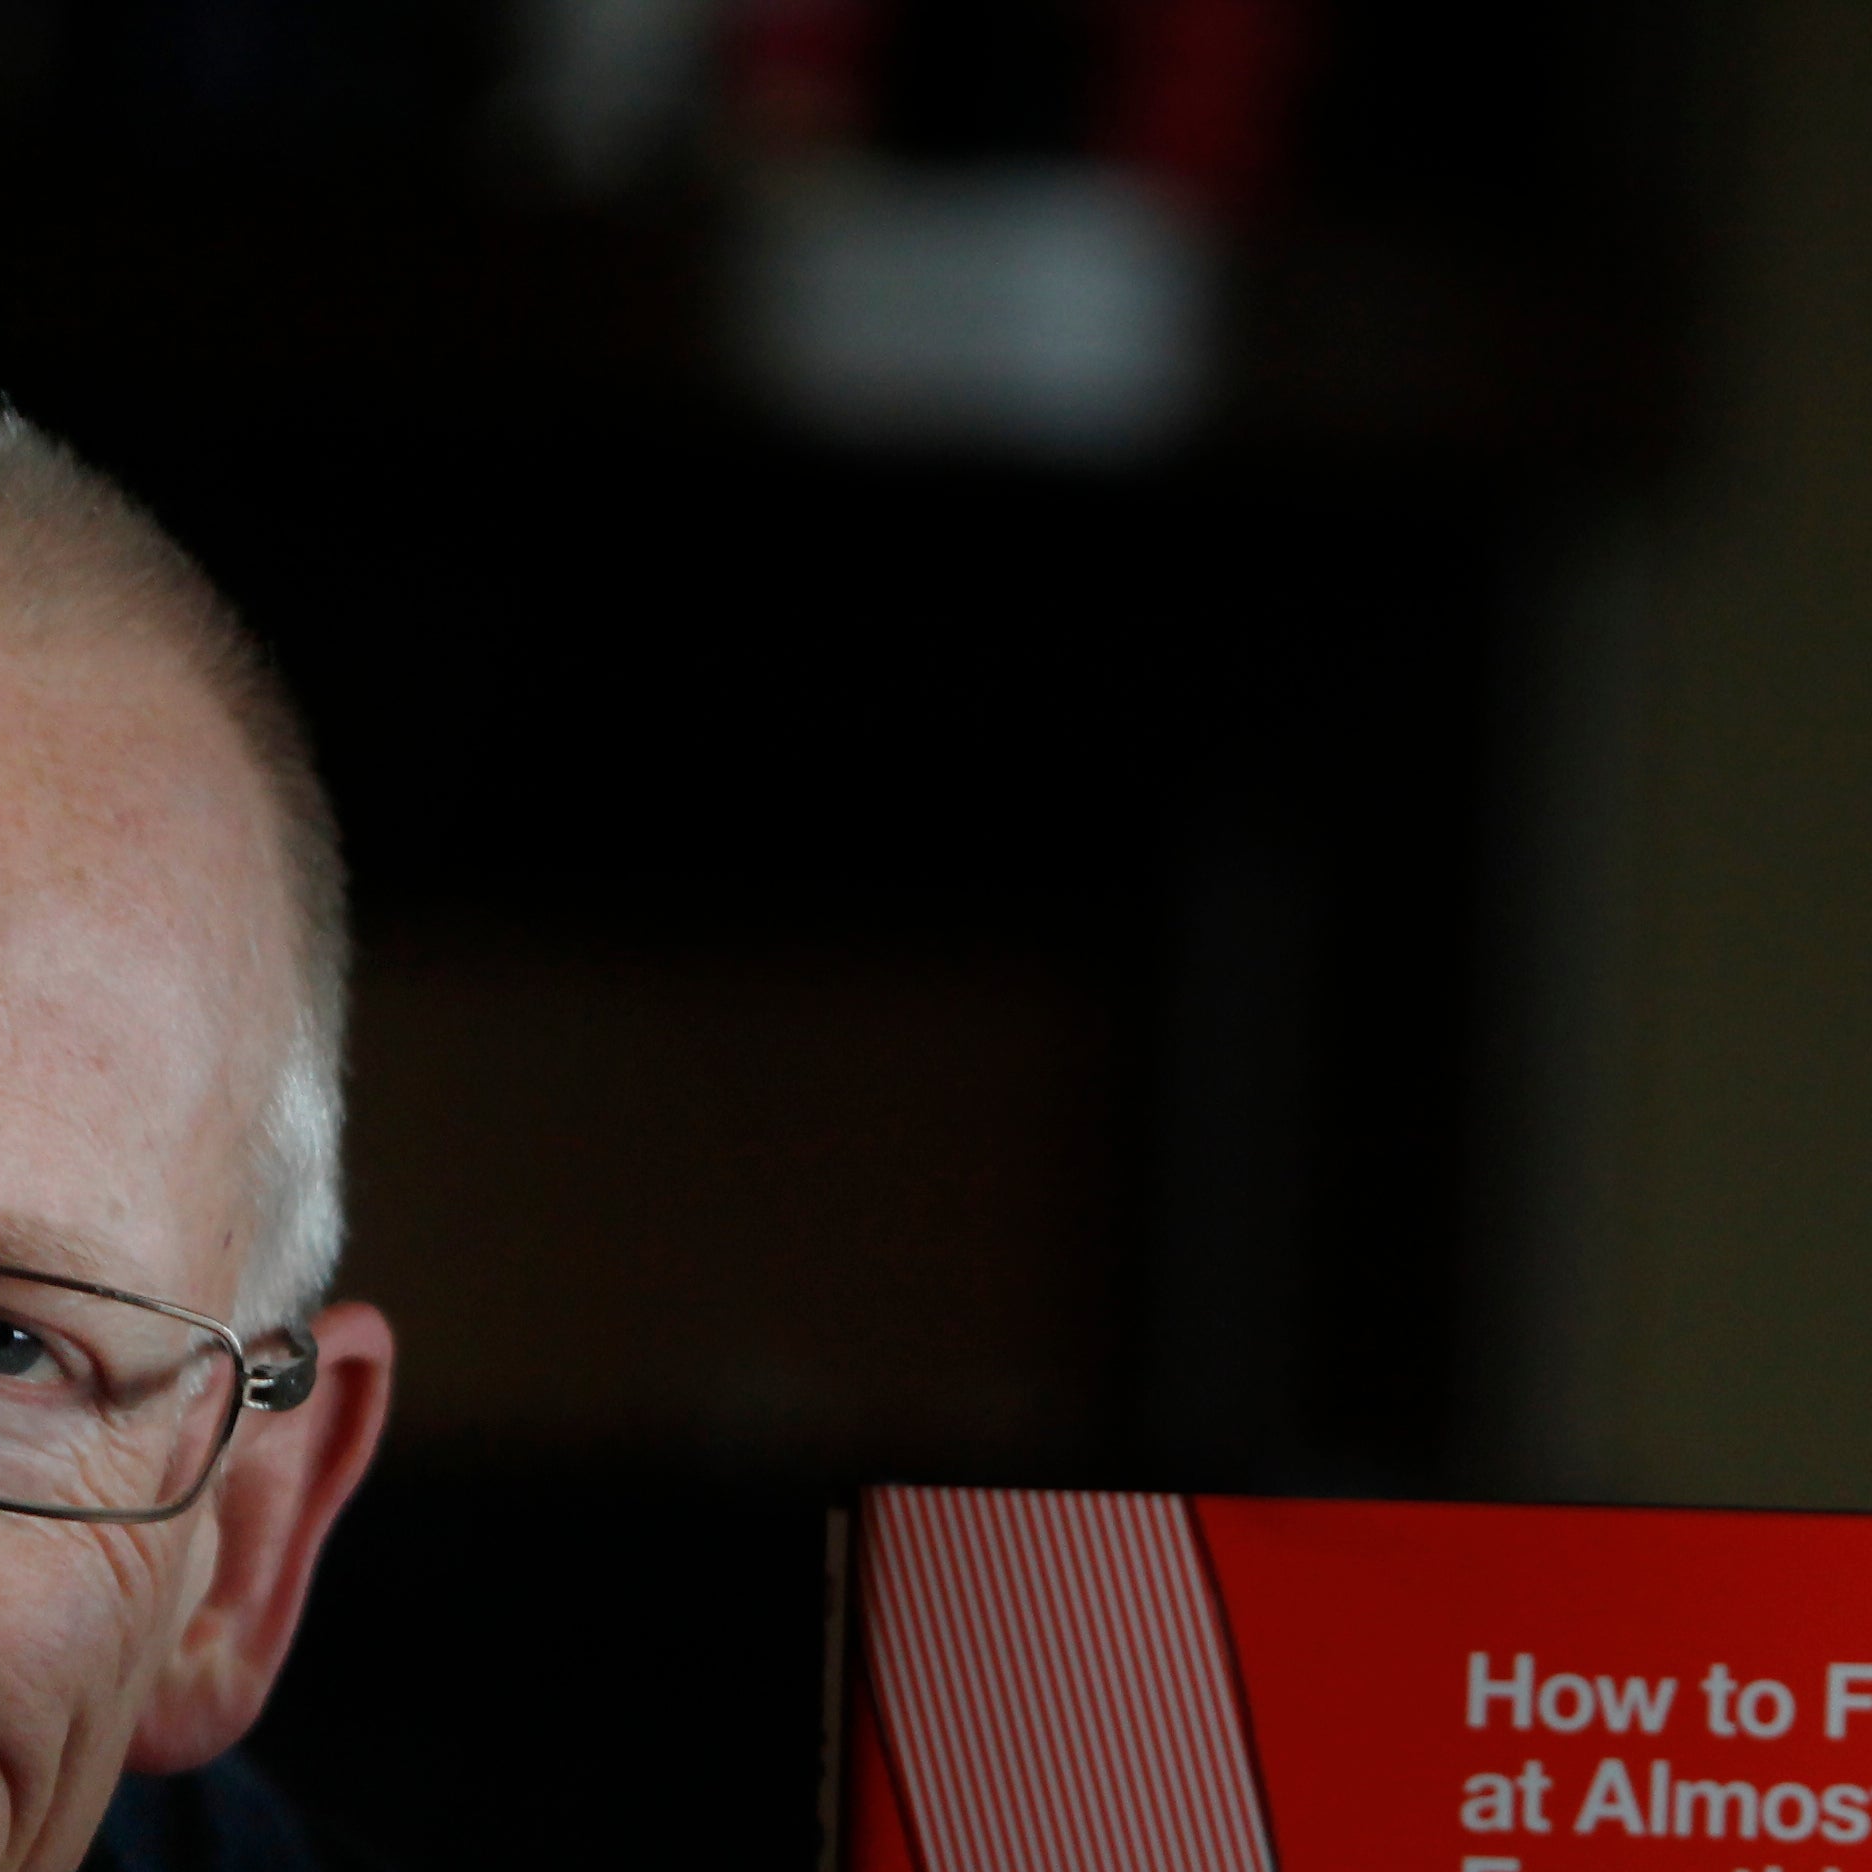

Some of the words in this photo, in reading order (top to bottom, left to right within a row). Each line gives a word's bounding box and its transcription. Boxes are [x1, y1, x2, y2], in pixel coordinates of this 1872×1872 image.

[1467, 1652, 1678, 1734] How
[1701, 1663, 1796, 1739] to
[1461, 1760, 1552, 1834] at
